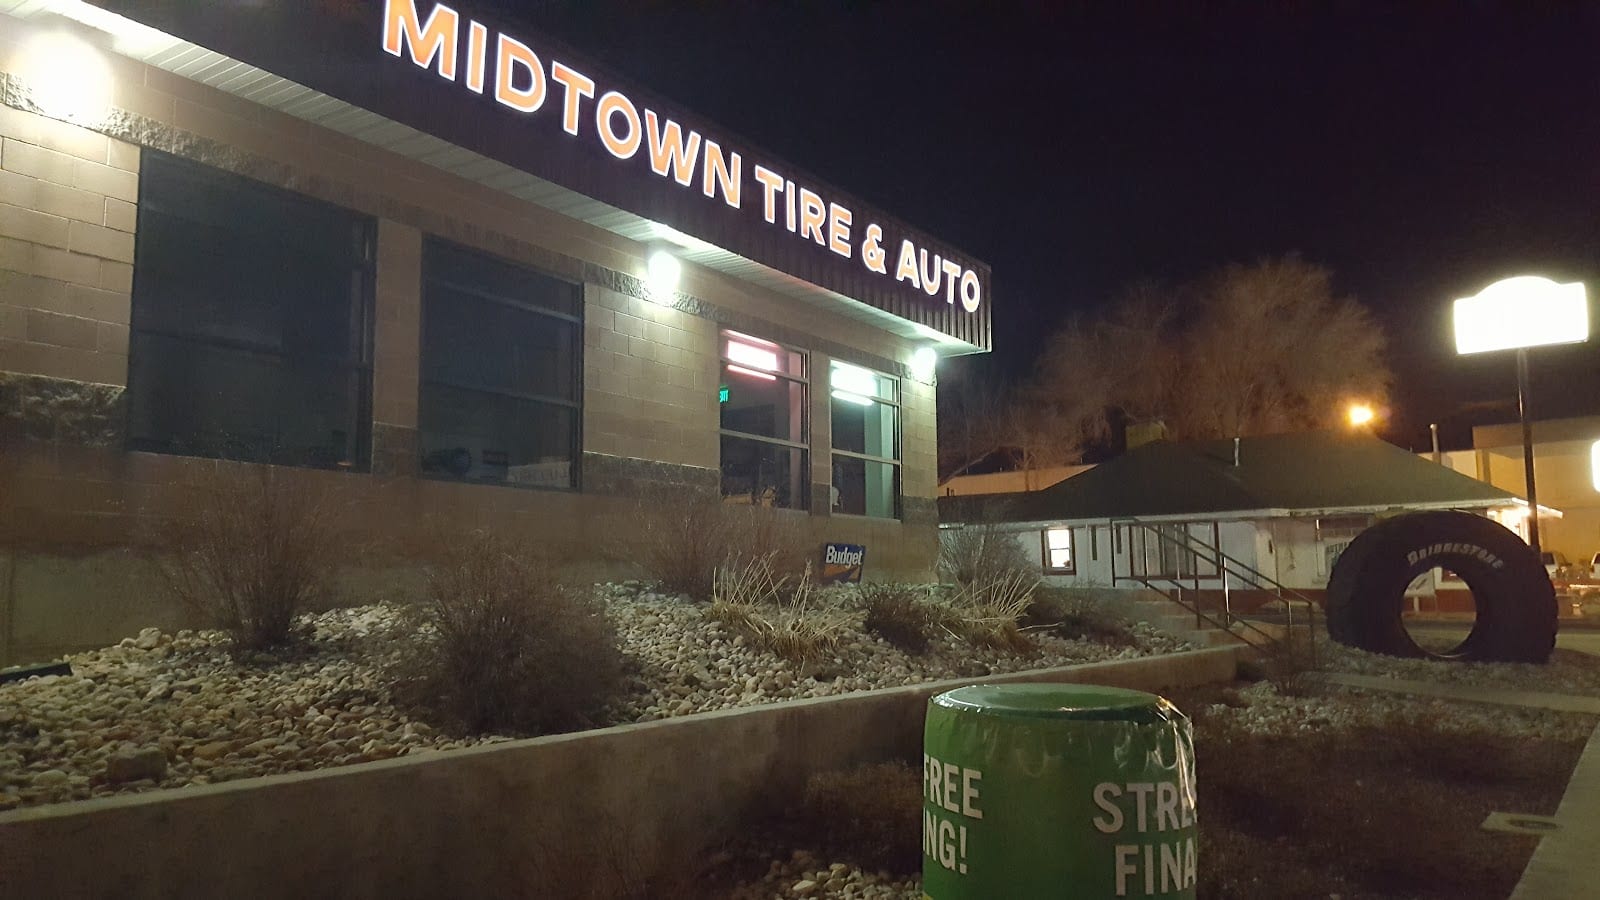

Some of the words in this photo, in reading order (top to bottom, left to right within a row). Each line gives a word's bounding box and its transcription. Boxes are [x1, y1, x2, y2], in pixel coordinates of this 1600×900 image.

[382, 0, 743, 209] MIDTOWN
[754, 165, 853, 259] TIRE
[862, 223, 887, 275] &
[896, 239, 982, 313] AUTO
[826, 545, 863, 567] Budget
[923, 753, 983, 820] FREE
[1092, 778, 1197, 833] STRE
